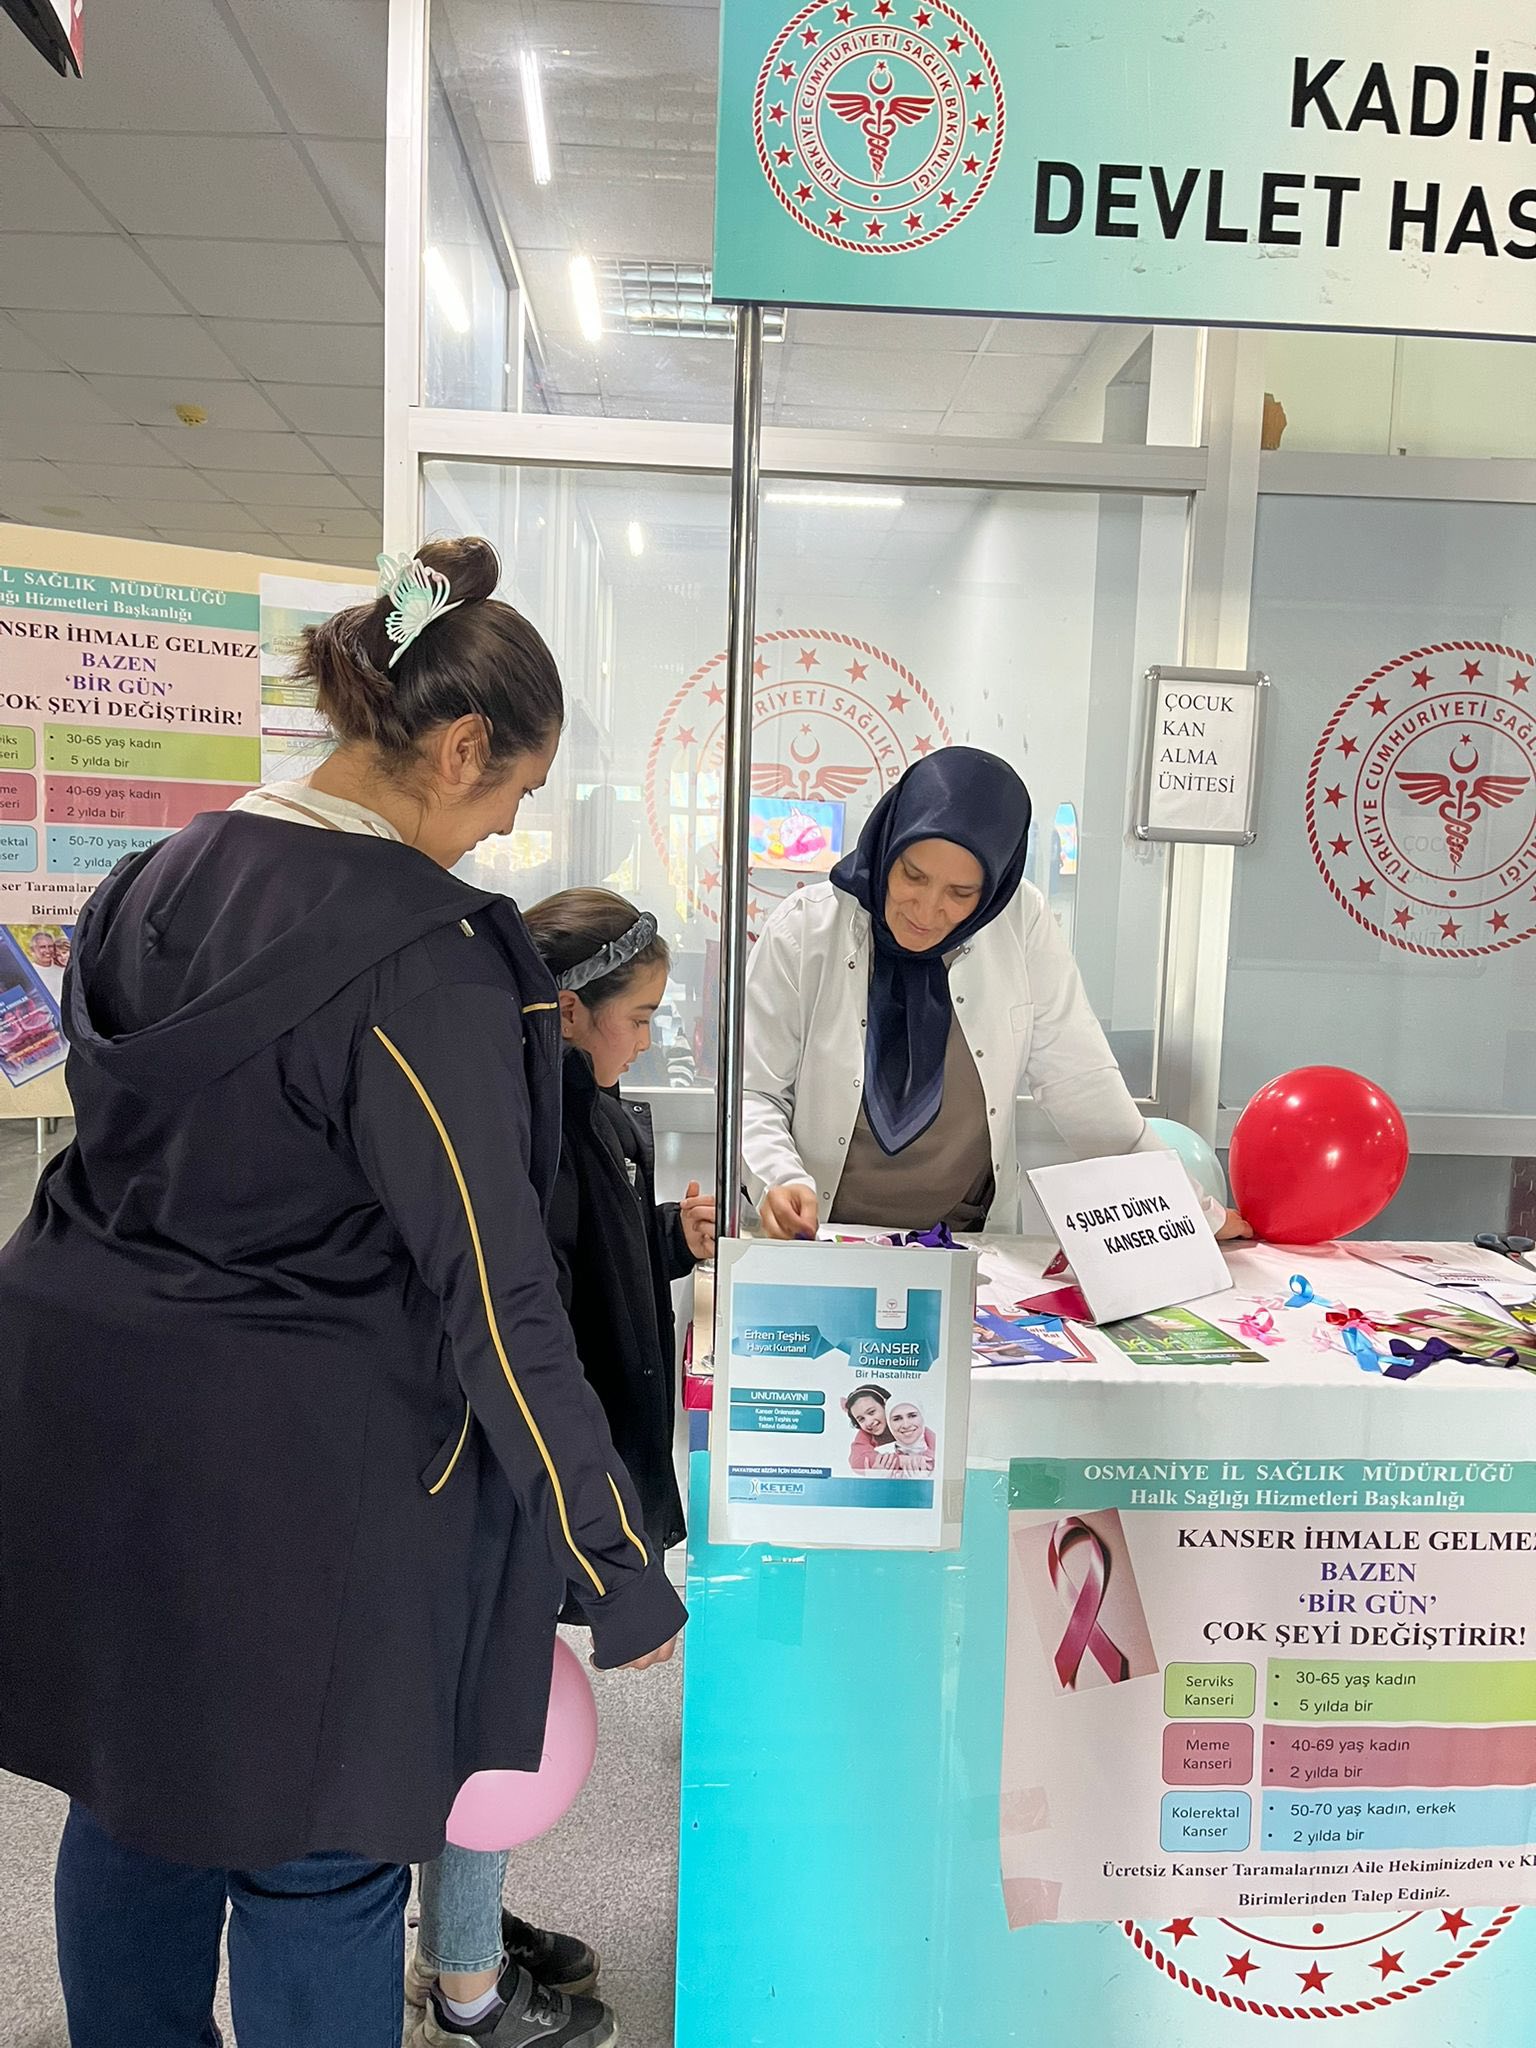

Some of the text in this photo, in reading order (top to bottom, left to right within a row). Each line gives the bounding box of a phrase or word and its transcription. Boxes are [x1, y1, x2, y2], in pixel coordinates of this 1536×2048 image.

[800, 33, 957, 192] TÜRKİYE CUMHURİYETİ SAĞLIK BAKANLIĞI
[1033, 160, 1536, 260] DEVLET HAS
[0, 567, 226, 606] L SAĞLIK MÜDÜRLÜĞÜ
[25, 591, 108, 612] Hizmetleri
[113, 601, 192, 623] Başkanlığı
[66, 623, 159, 649] İHMALE
[165, 636, 259, 659] GELMEZ
[82, 652, 156, 672] BAZEN
[48, 697, 101, 715] ŞEYİ
[107, 701, 242, 725] DEĞİŞTİRİR!
[1165, 693, 1234, 713] ÇOCUK
[832, 697, 896, 761] SAĞLIK
[1163, 720, 1205, 737] KAN
[66, 733, 162, 749] 30-65 yaş kadın
[1366, 700, 1487, 791] CUMHURİYETİ
[71, 755, 130, 768] 5 yılda bir
[1160, 748, 1218, 765] ALMA
[1159, 771, 1236, 793] ÜNİTESİ
[66, 785, 161, 799] 40-69 yaş kadın
[67, 807, 126, 819] 2 yılda bir
[69, 835, 104, 847] 50-70
[107, 838, 128, 849] yaş
[1363, 799, 1410, 885] TÜRKİYE
[73, 857, 81, 867] 2
[84, 857, 112, 869] yılda
[1066, 1196, 1170, 1232] 4 ŞUBAT DÜNYA
[1104, 1215, 1196, 1255] KANSER GÜNÜ
[744, 1329, 811, 1343] Erken Teşhis
[747, 1343, 772, 1353] Hayat
[859, 1342, 920, 1354] KANSER
[856, 1370, 869, 1378] Bir
[1083, 1461, 1514, 1482] OSMANİYE İL SAĞLIK MÜDÜRLÜĞÜ
[760, 1483, 804, 1492] KETEM
[1131, 1489, 1465, 1511] Halk Sağlığı Hizmetleri Başkanlığı
[1177, 1526, 1536, 1551] KANSER İHMALE GELME
[1320, 1561, 1417, 1583] BAZEN
[1203, 1620, 1526, 1650] ÇOK ŞEYİ DEĞİŞTİRİR!
[1186, 1675, 1234, 1687] Serviks
[1296, 1671, 1416, 1688] 30-65 yaş kadın
[1184, 1694, 1234, 1705] Kanseri
[1299, 1699, 1373, 1715] 5 yılda bir
[1186, 1739, 1230, 1751] Meme
[1291, 1738, 1410, 1754] 40-69 yaş kadın
[1183, 1757, 1232, 1769] Kanseri
[1290, 1766, 1363, 1782] 2 yılda bir
[1172, 1806, 1240, 1818] Kolerektal
[1290, 1803, 1333, 1816] 50-70
[1337, 1806, 1362, 1818] yaş
[1416, 1802, 1456, 1814] erkek
[1182, 1825, 1228, 1837] Kanser
[1293, 1829, 1365, 1846] 2 yılda bir
[1103, 1861, 1166, 1877] Ücretsiz
[1171, 1863, 1228, 1877] Kanser
[1232, 1863, 1349, 1876] Taramalarınızı
[1352, 1860, 1384, 1874] Aile
[1389, 1858, 1493, 1872] Hekiminizden
[1498, 1859, 1515, 1869] ve
[1238, 1886, 1450, 1906] Birimlerinden Talep Ediniz.
